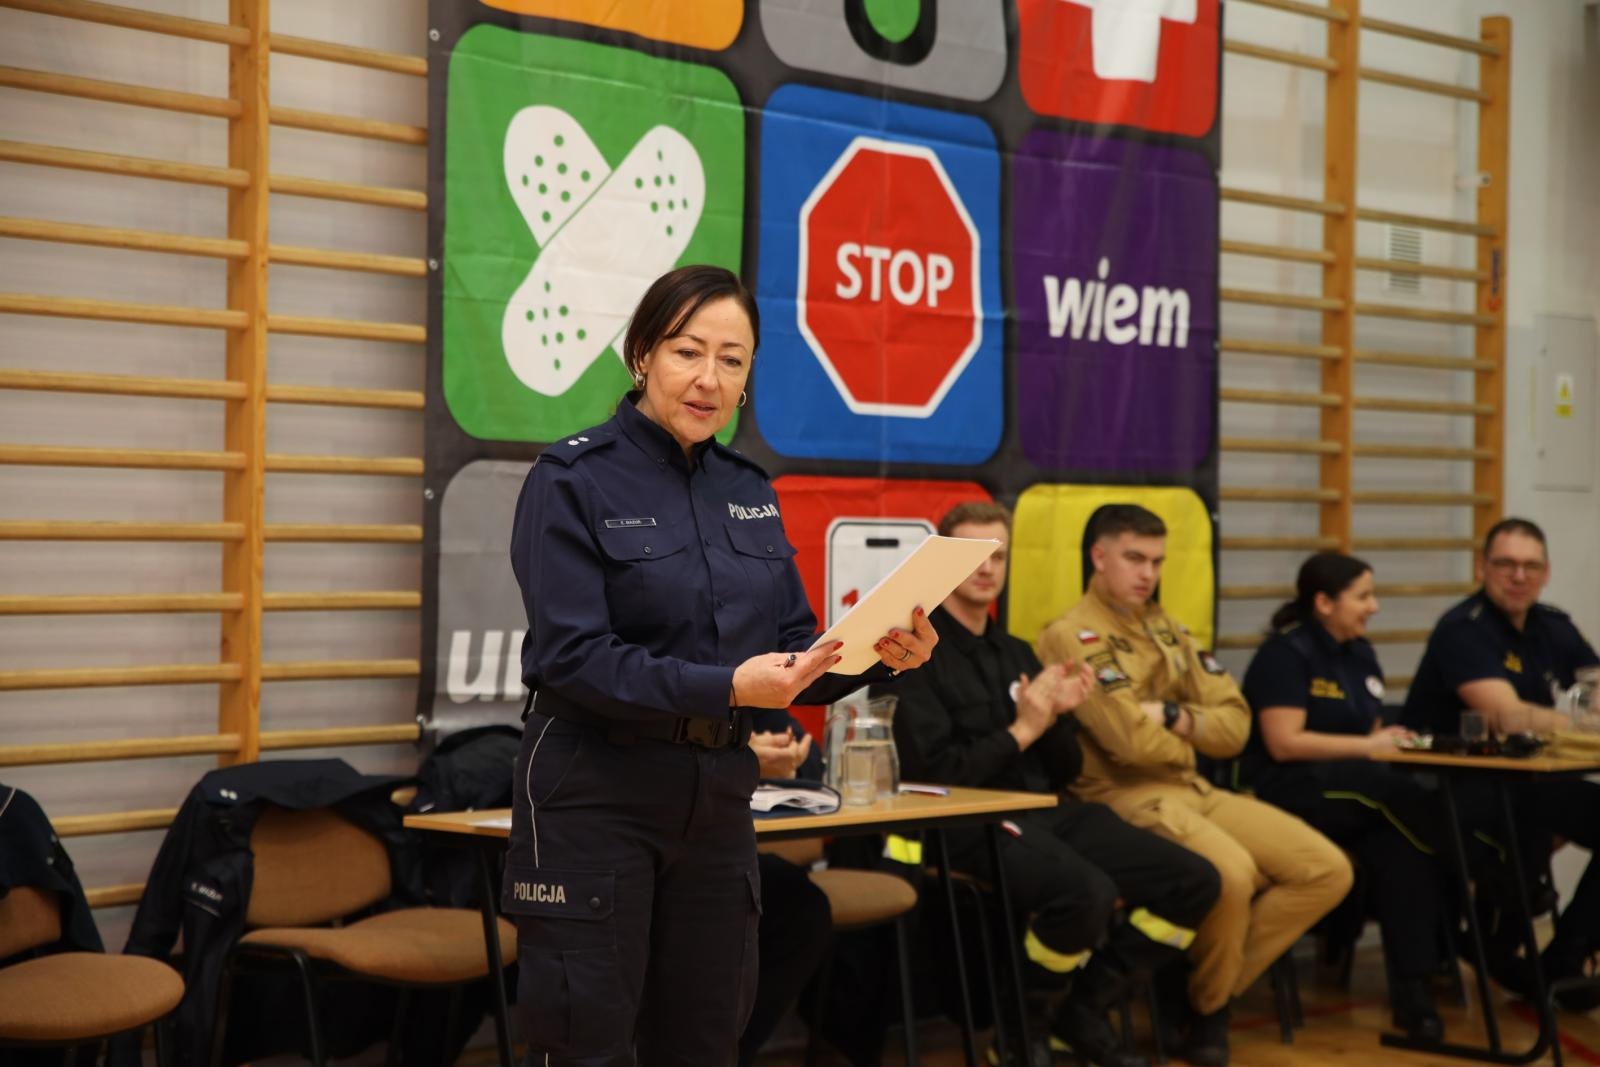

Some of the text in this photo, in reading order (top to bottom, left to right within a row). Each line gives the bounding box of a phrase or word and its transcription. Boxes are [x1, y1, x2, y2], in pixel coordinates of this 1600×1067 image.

[836, 241, 954, 308] STOP
[1043, 256, 1191, 348] wiem
[727, 502, 780, 520] POLICJA
[513, 881, 567, 904] POLICJA
